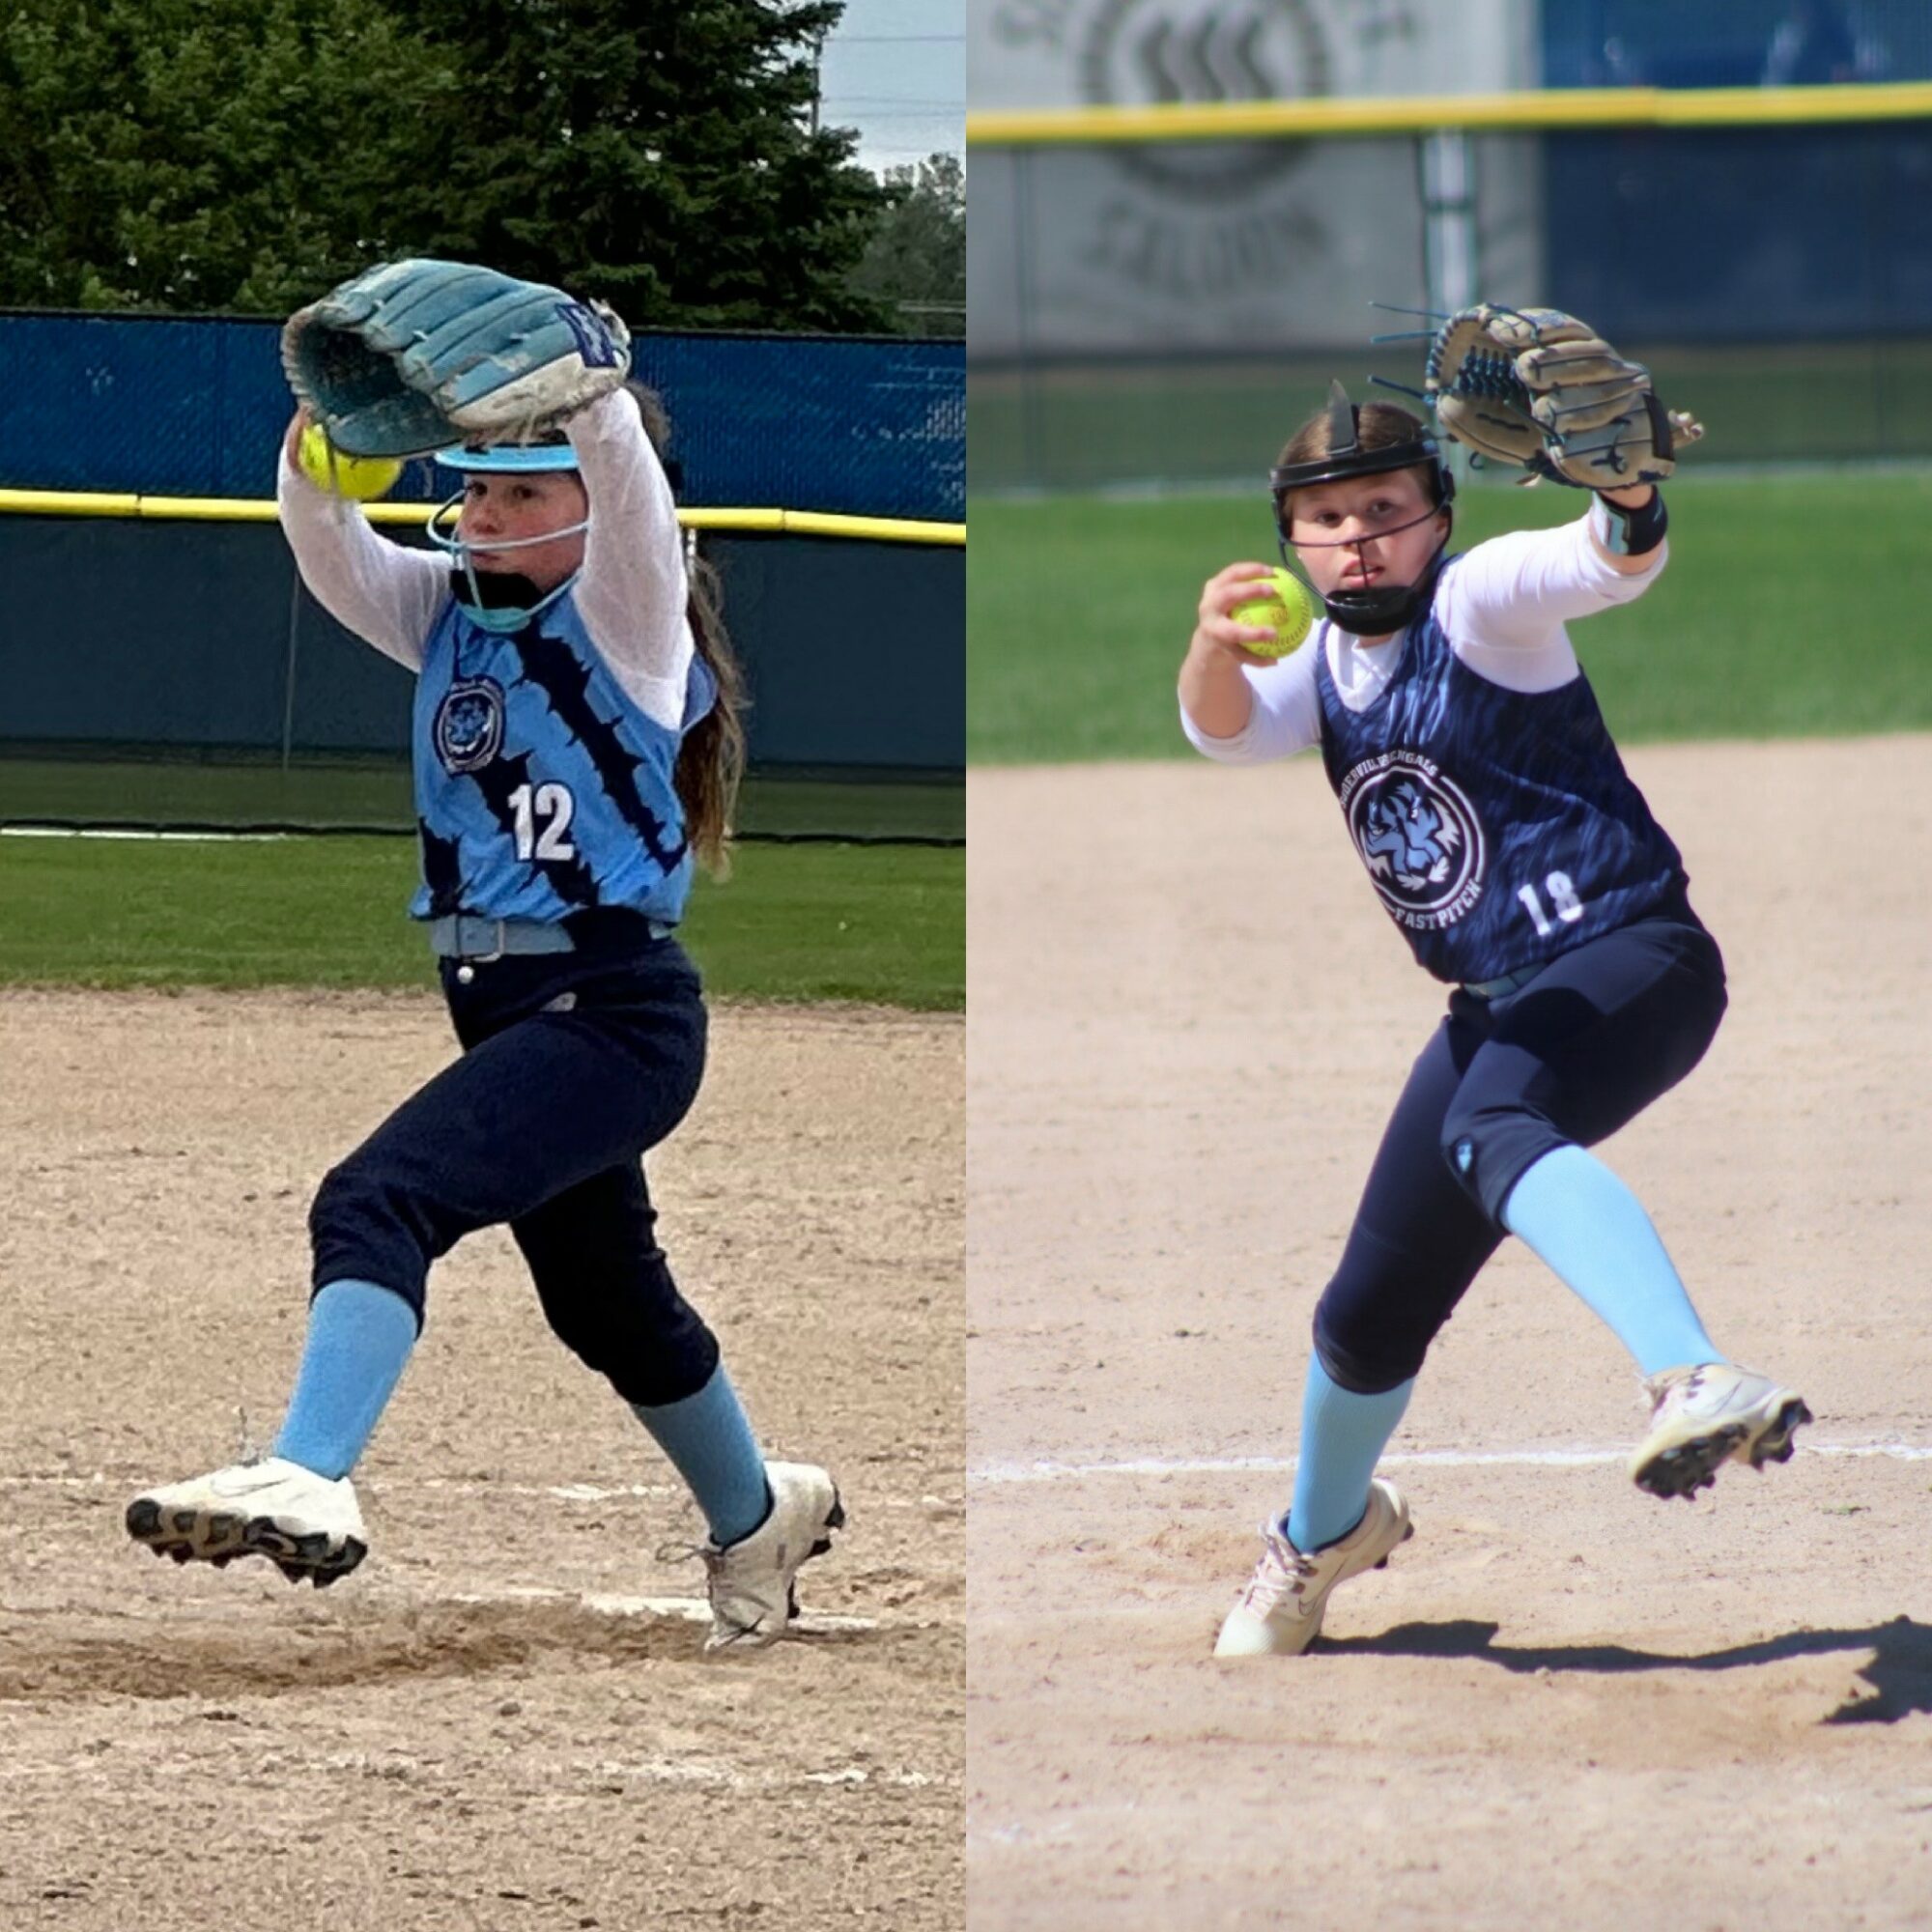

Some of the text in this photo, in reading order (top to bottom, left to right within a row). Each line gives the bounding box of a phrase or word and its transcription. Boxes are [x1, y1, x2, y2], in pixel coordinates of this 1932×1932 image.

[507, 783, 574, 861] 12
[1395, 878, 1482, 929] FASTPITCH
[1518, 870, 1582, 936] 18
